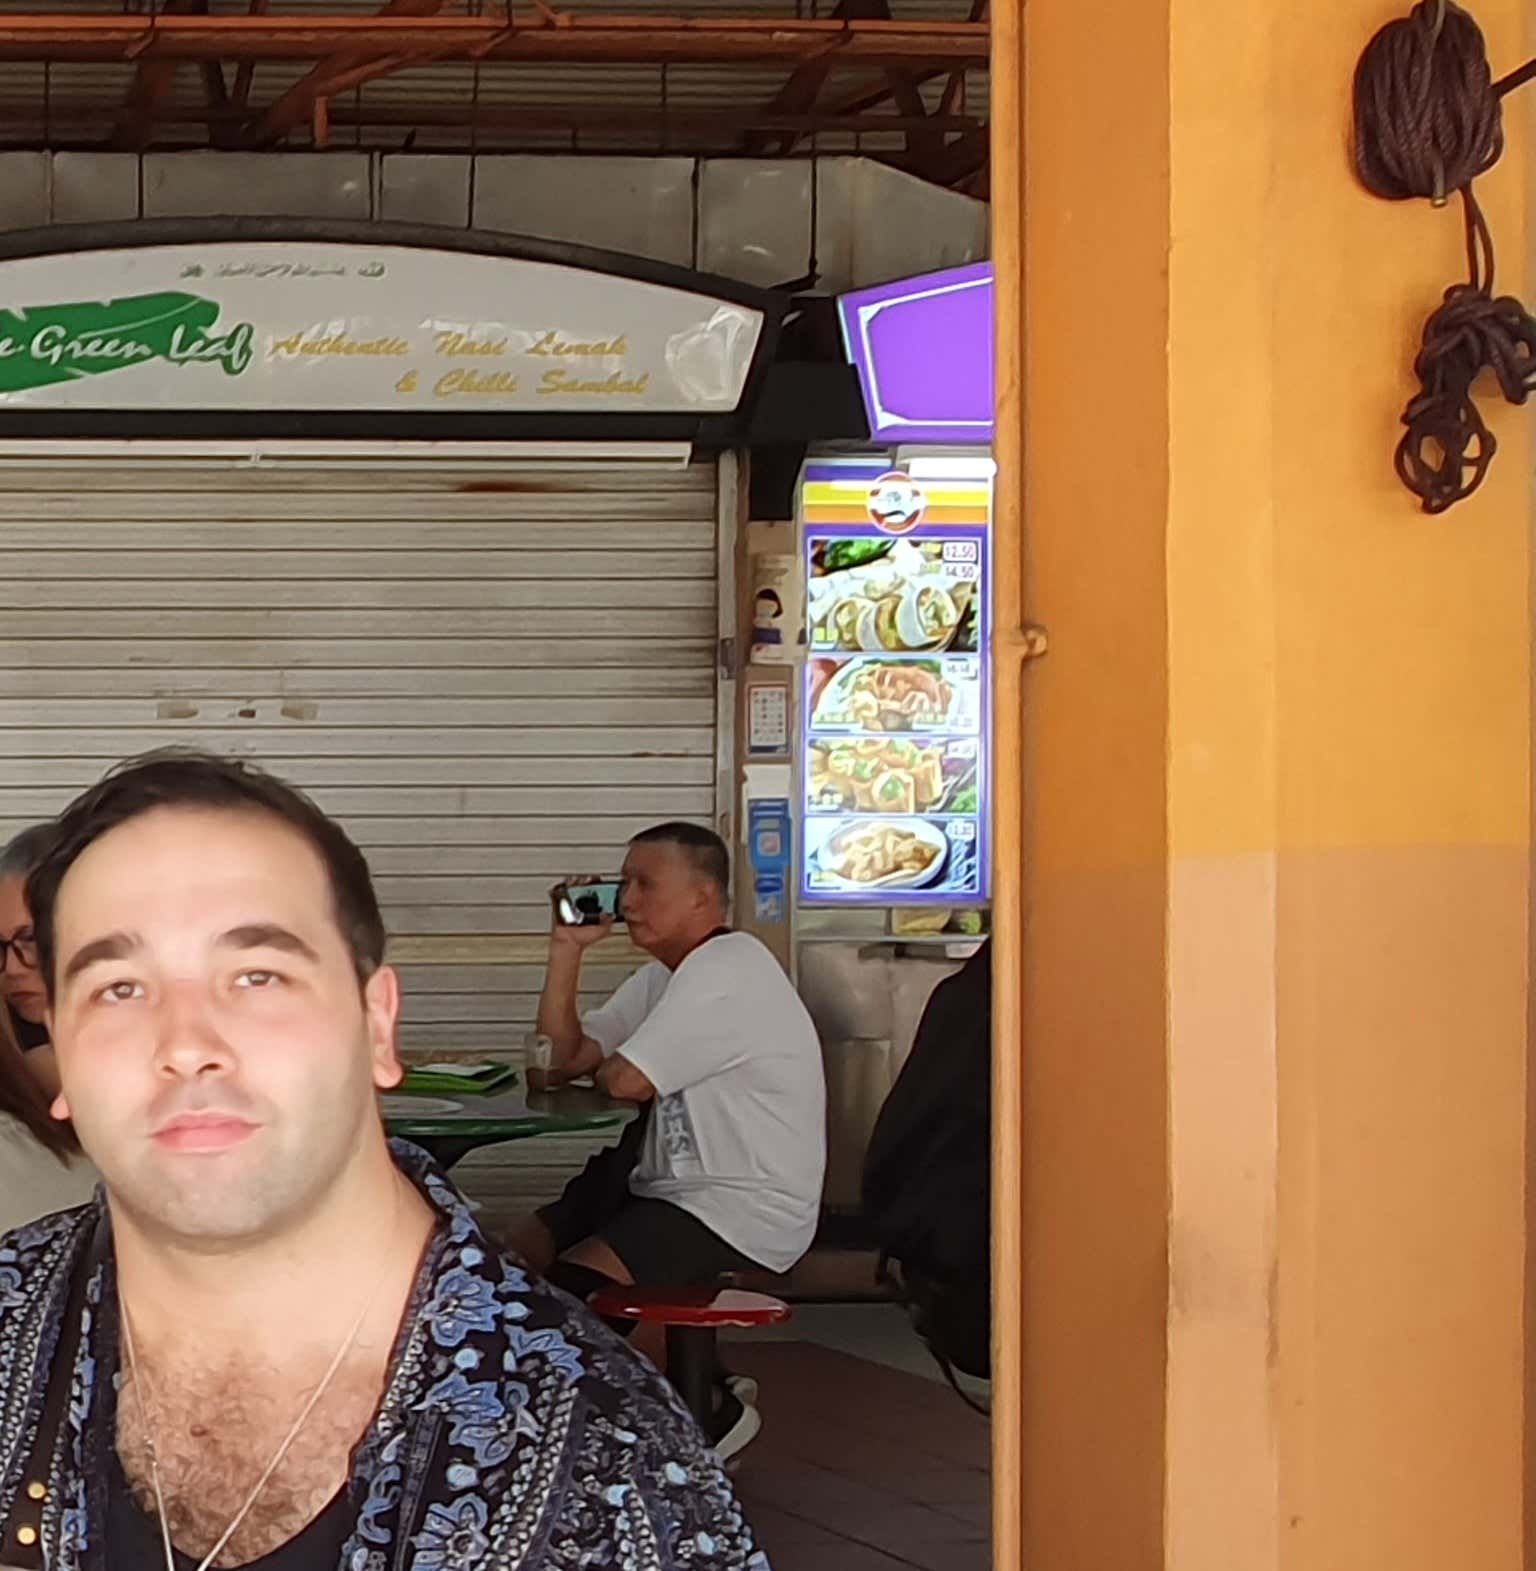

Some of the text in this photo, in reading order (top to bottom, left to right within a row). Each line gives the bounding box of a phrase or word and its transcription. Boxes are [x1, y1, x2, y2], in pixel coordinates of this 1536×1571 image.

[30, 325, 153, 365] Green
[168, 323, 254, 372] Leaf
[270, 330, 626, 357] Authentic Nasi Lemak
[432, 368, 519, 398] Chilli
[535, 369, 650, 395] Sambal
